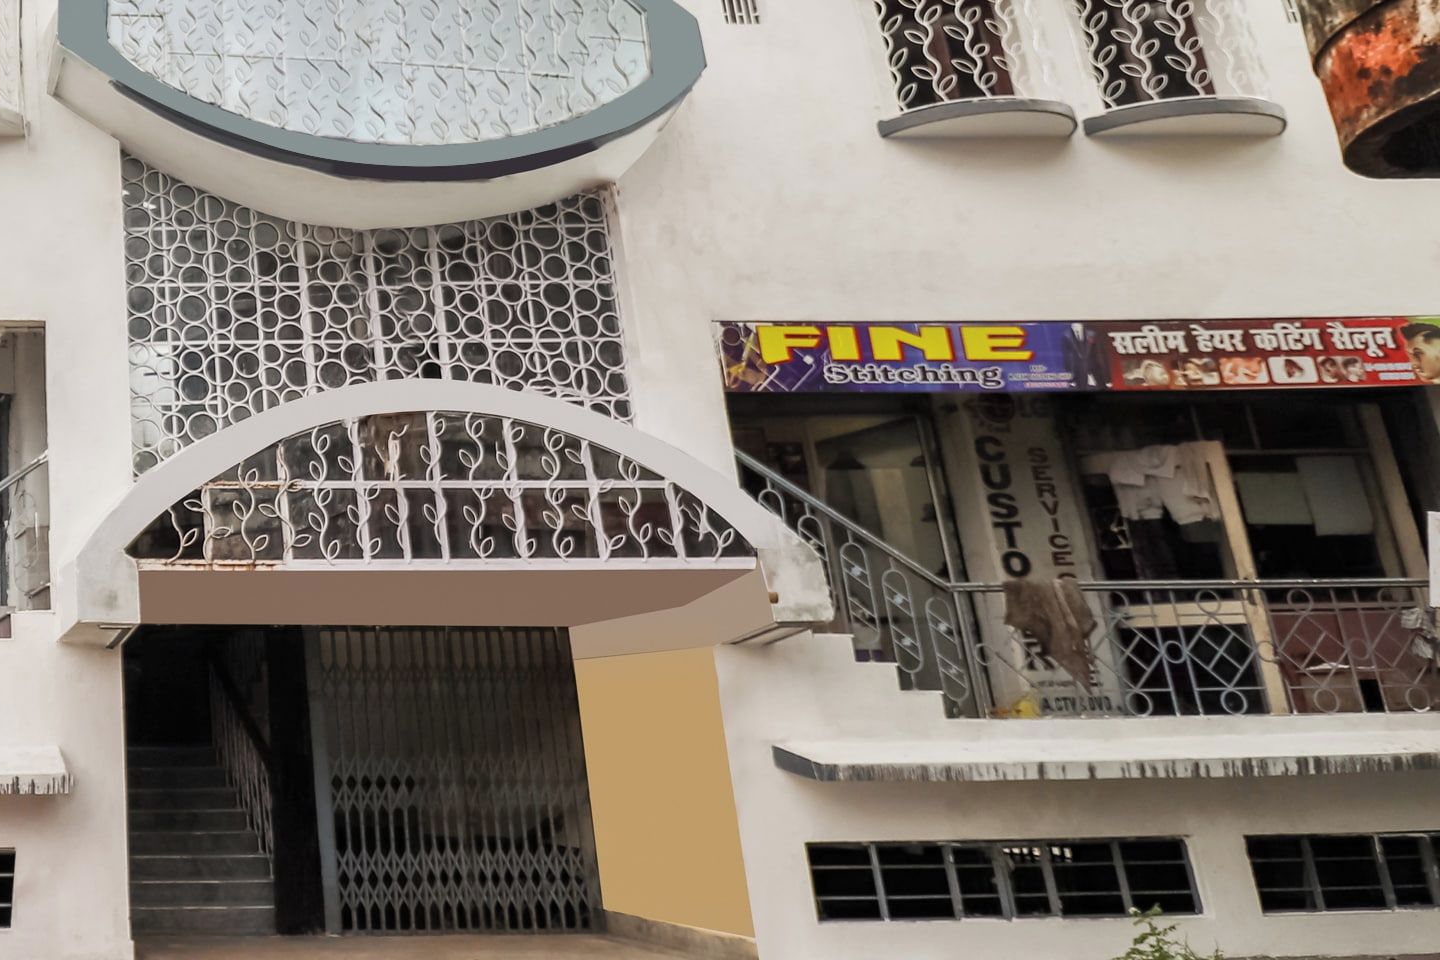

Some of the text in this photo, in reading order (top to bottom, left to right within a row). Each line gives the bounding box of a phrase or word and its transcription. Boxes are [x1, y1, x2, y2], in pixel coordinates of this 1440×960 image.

[756, 325, 1034, 365] FINE
[1109, 321, 1396, 358] सलीम हेयर कटिंग सैलून
[823, 363, 1004, 388] Stitching
[1027, 447, 1075, 567] SERVICE
